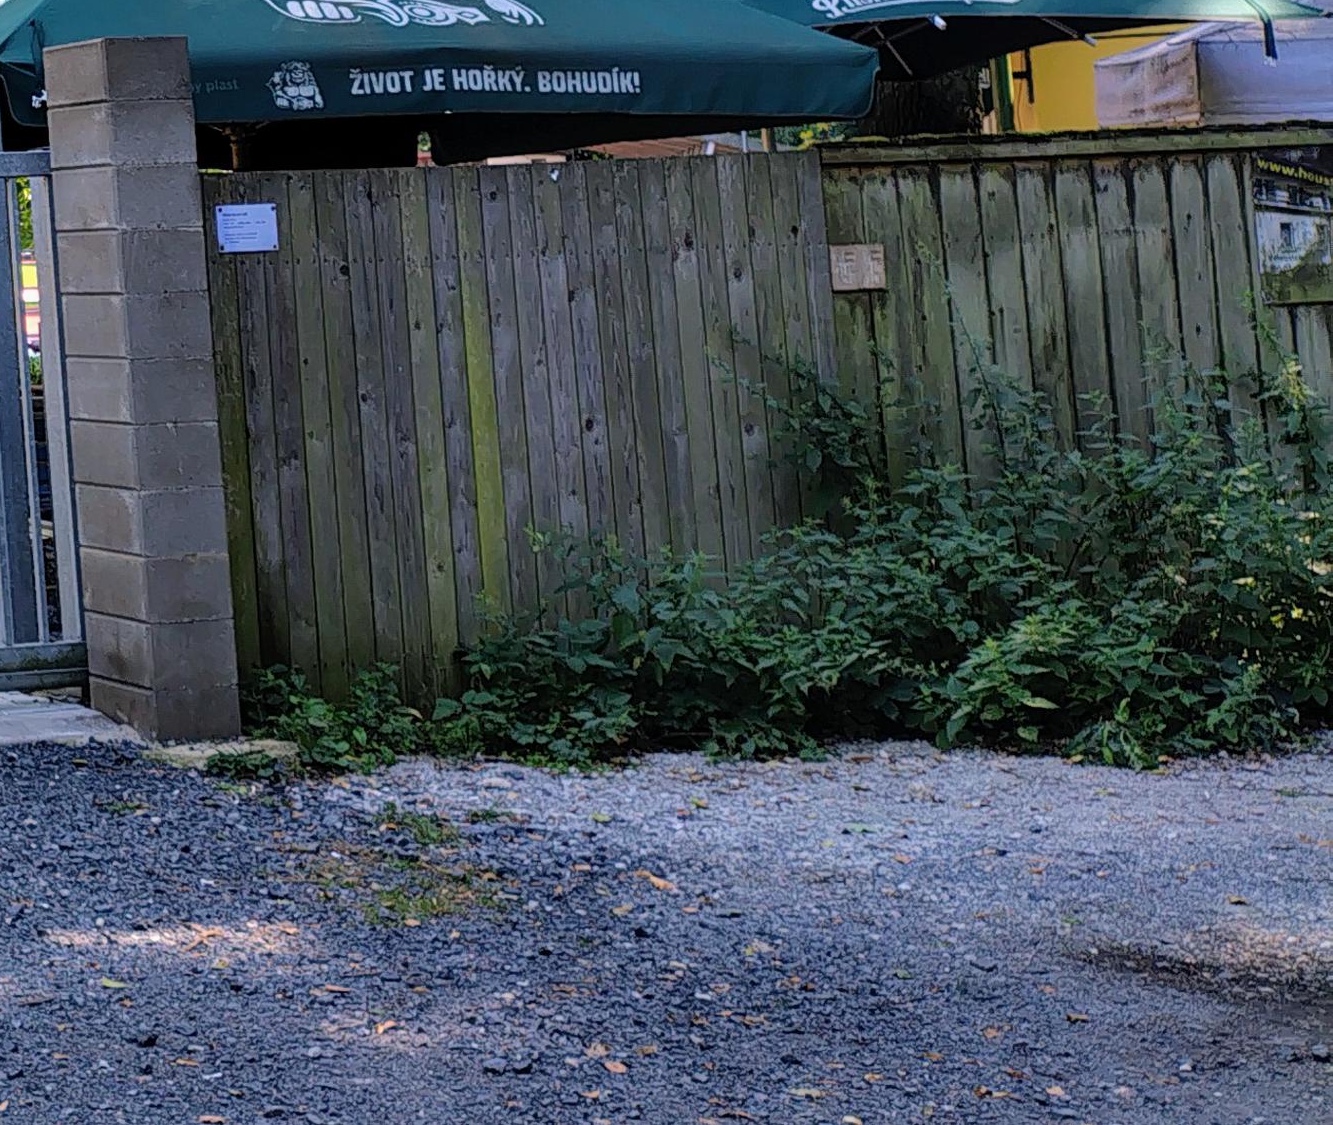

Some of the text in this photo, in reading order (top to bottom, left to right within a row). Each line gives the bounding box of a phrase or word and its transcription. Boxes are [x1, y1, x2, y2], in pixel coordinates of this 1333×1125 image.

[349, 64, 641, 95] ŽIVOT JE HOŘKÝ. BOHUDÍK!
